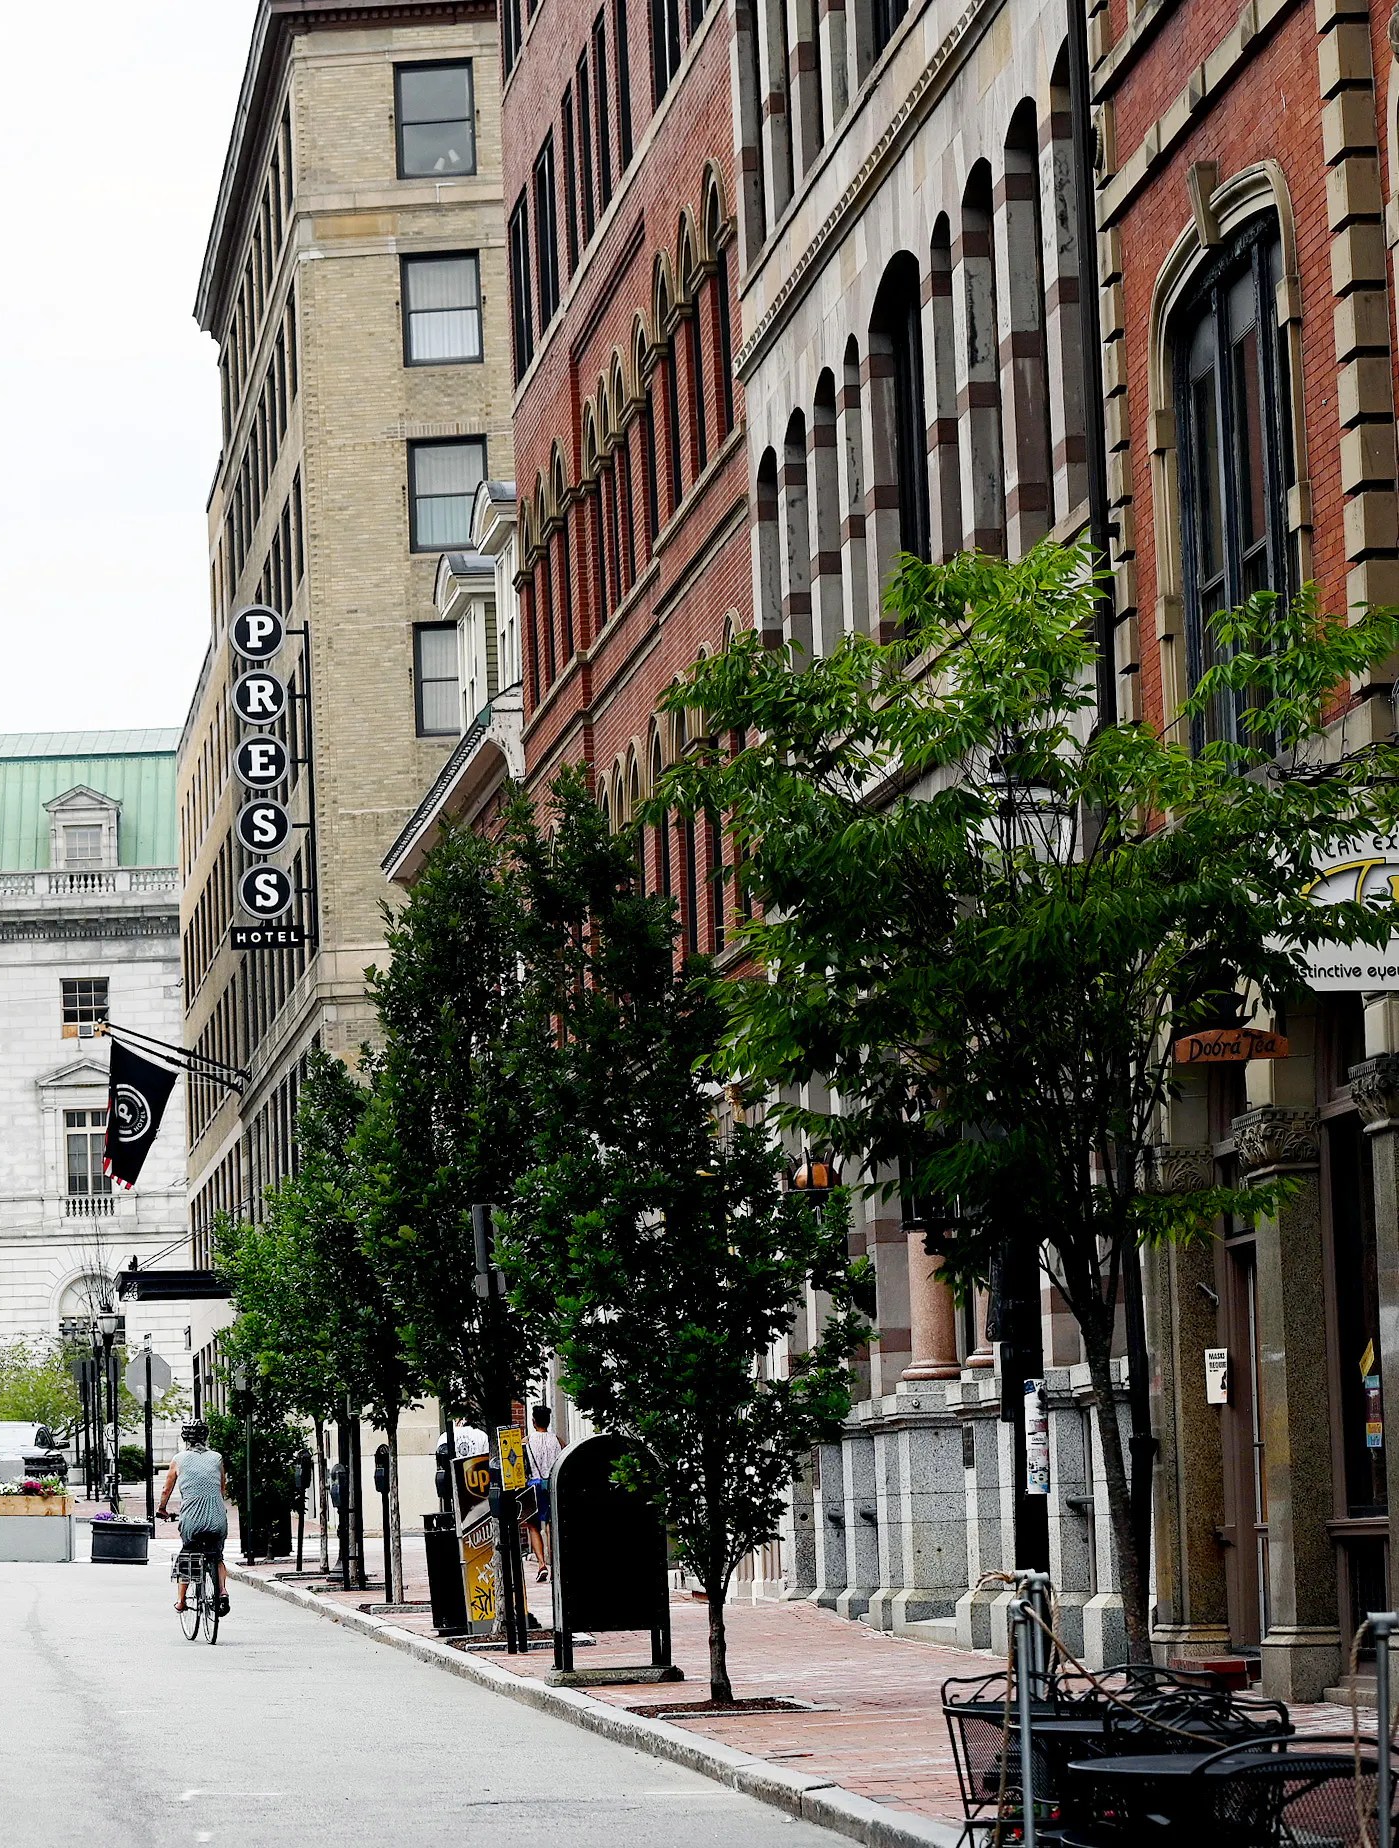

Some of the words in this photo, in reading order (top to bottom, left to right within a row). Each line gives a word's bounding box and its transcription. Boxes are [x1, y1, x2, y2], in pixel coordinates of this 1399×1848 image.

[245, 615, 280, 908] PRESS
[236, 931, 299, 944] HOTEL
[1242, 1030, 1277, 1060] Tea
[133, 1110, 146, 1133] HOTEL
[467, 1469, 490, 1493] up
